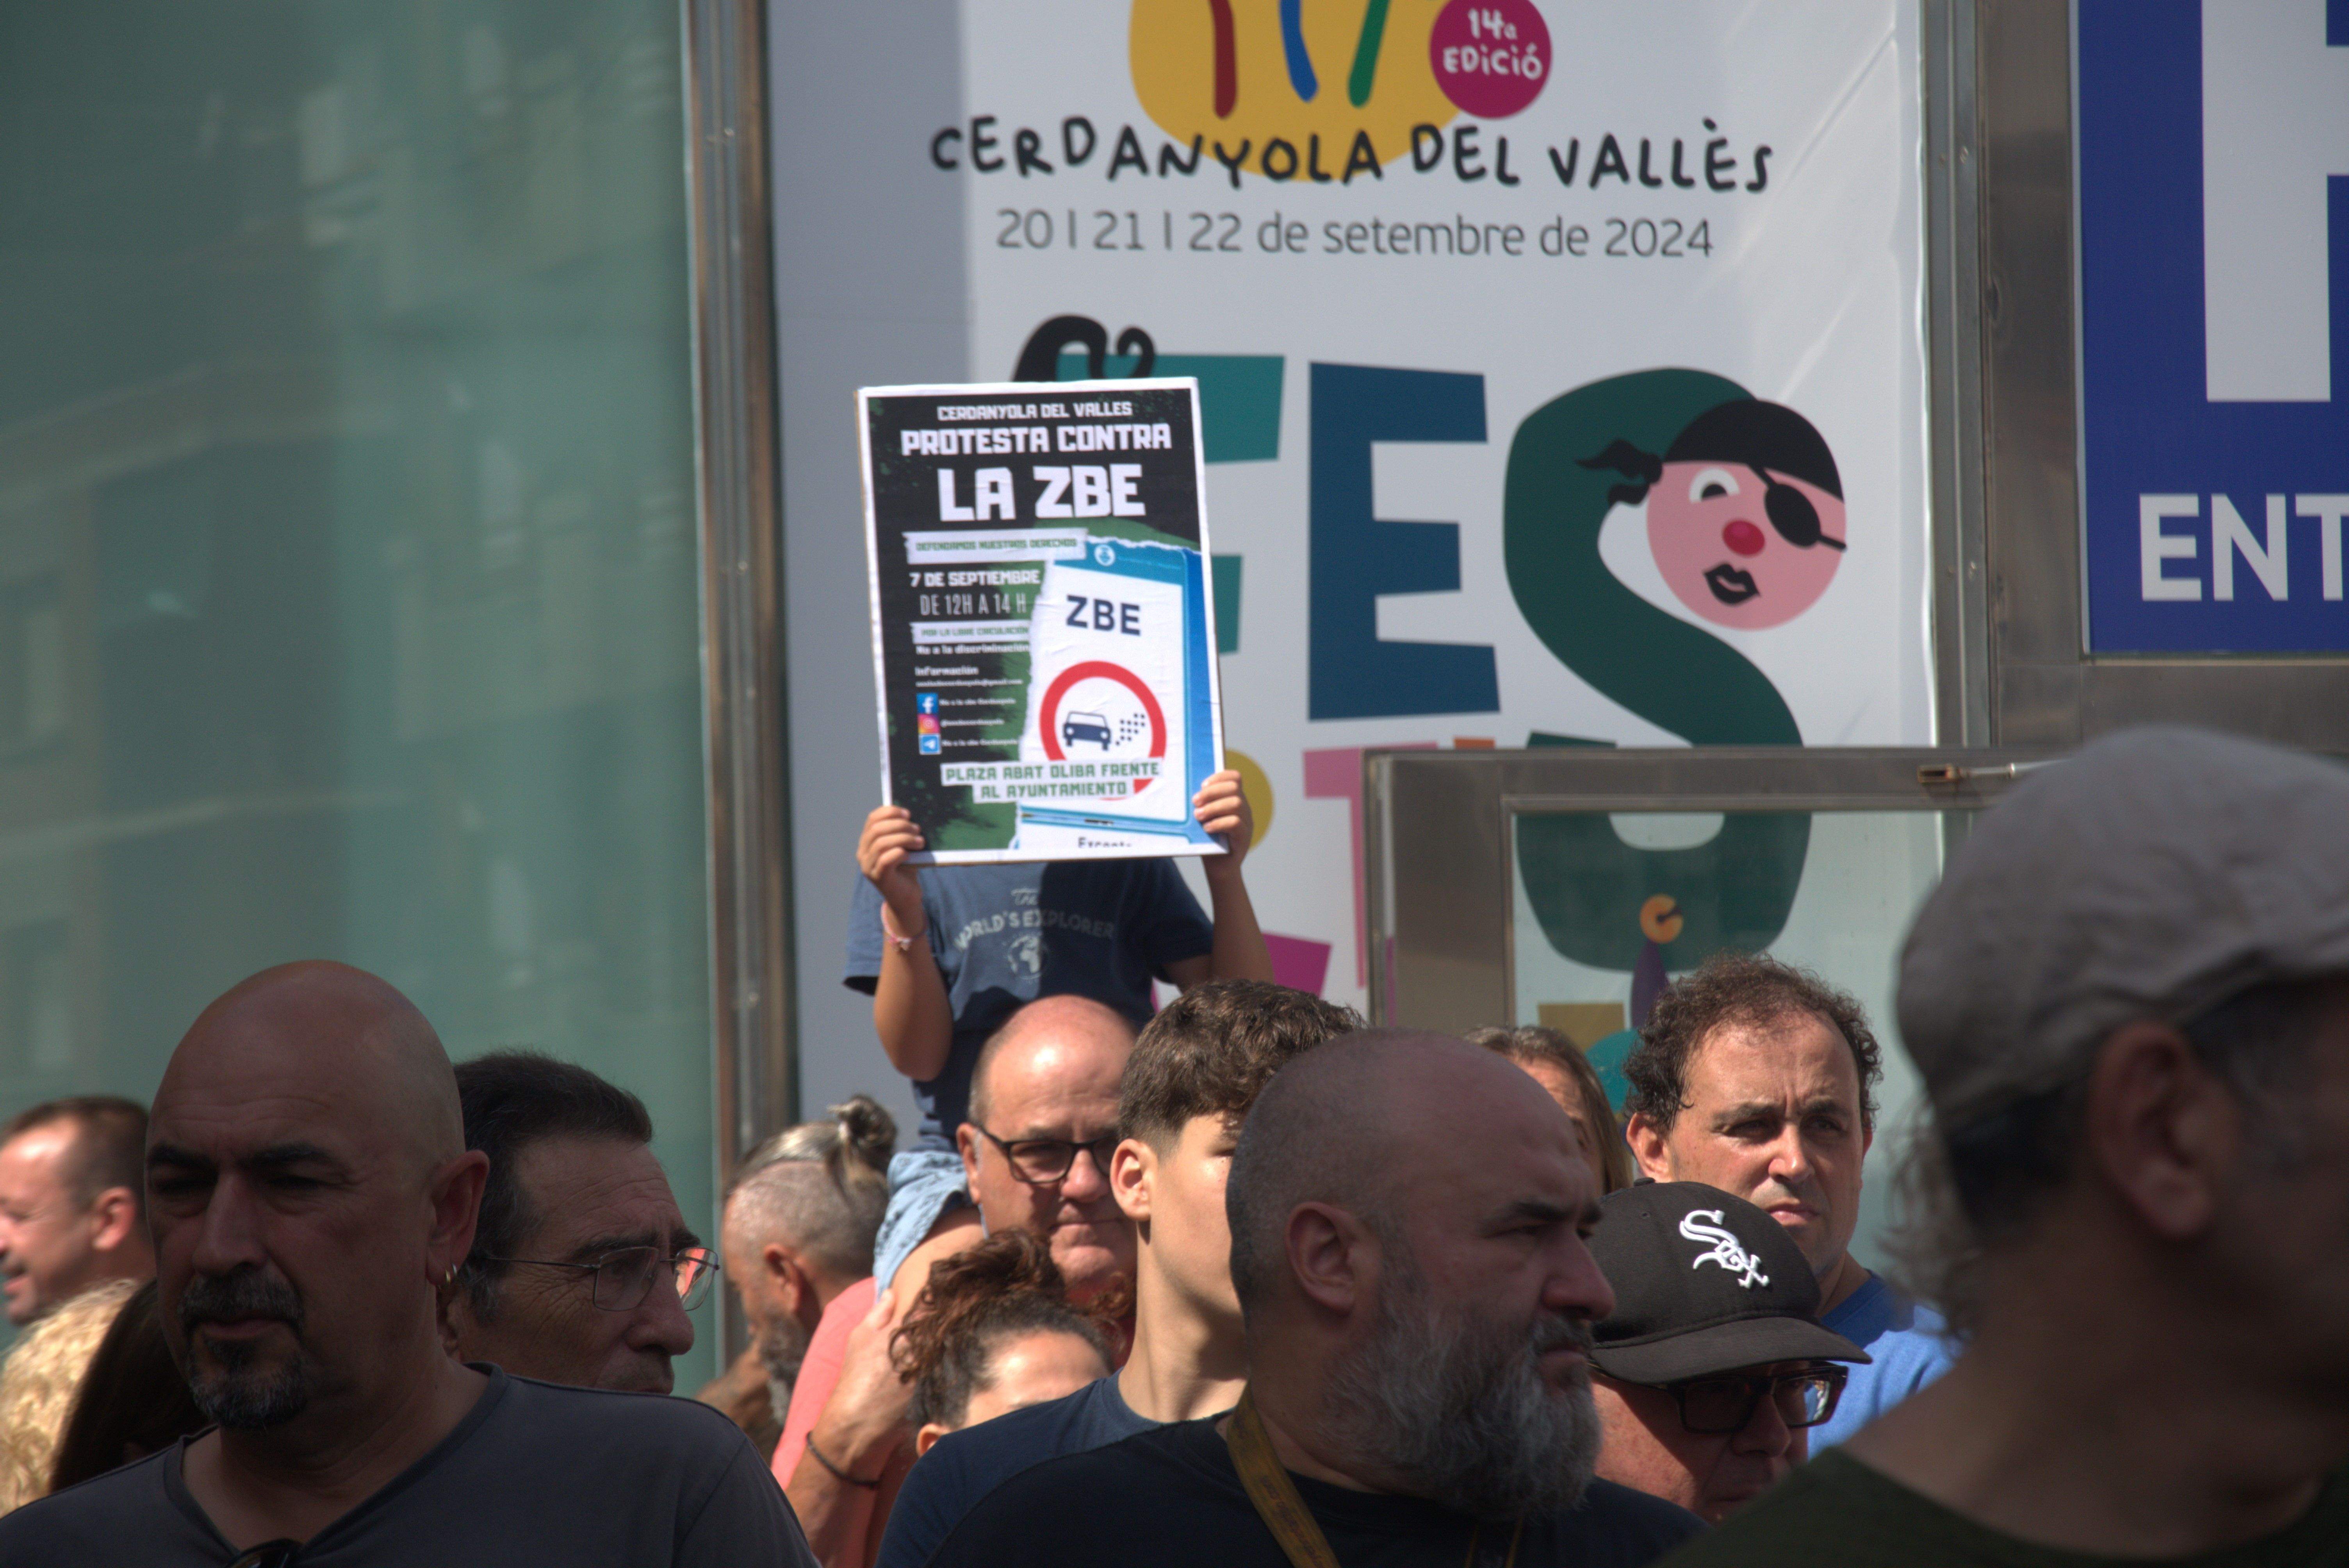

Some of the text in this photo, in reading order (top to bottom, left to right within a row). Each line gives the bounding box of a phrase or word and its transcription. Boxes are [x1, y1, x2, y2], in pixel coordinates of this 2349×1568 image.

[930, 115, 1773, 194] CERDANYOLA DEL VALLÈS
[997, 207, 1053, 249] 20
[1094, 210, 1145, 251] 21
[1188, 212, 1242, 252] 22
[1257, 210, 1309, 253] de
[1322, 212, 1525, 257] setembre
[1539, 214, 1590, 257] de
[1604, 216, 1714, 258] 2024
[937, 401, 1133, 421] CERDANYOLA DEL VALLES
[901, 424, 1172, 455] PROTESTA CONTRA
[937, 464, 1146, 521] LA ZBE
[909, 570, 1041, 587] 7 DE SEPTIEMBRE
[920, 592, 1026, 616] DE 12H A 14 H
[1066, 594, 1141, 637] ZBE
[946, 762, 1160, 781] PLAZA ABAT OLIBA FRENTE
[981, 782, 1127, 798] AL AYUNTAMIENTO
[954, 908, 1115, 951] WORLD'S EXPLORER
